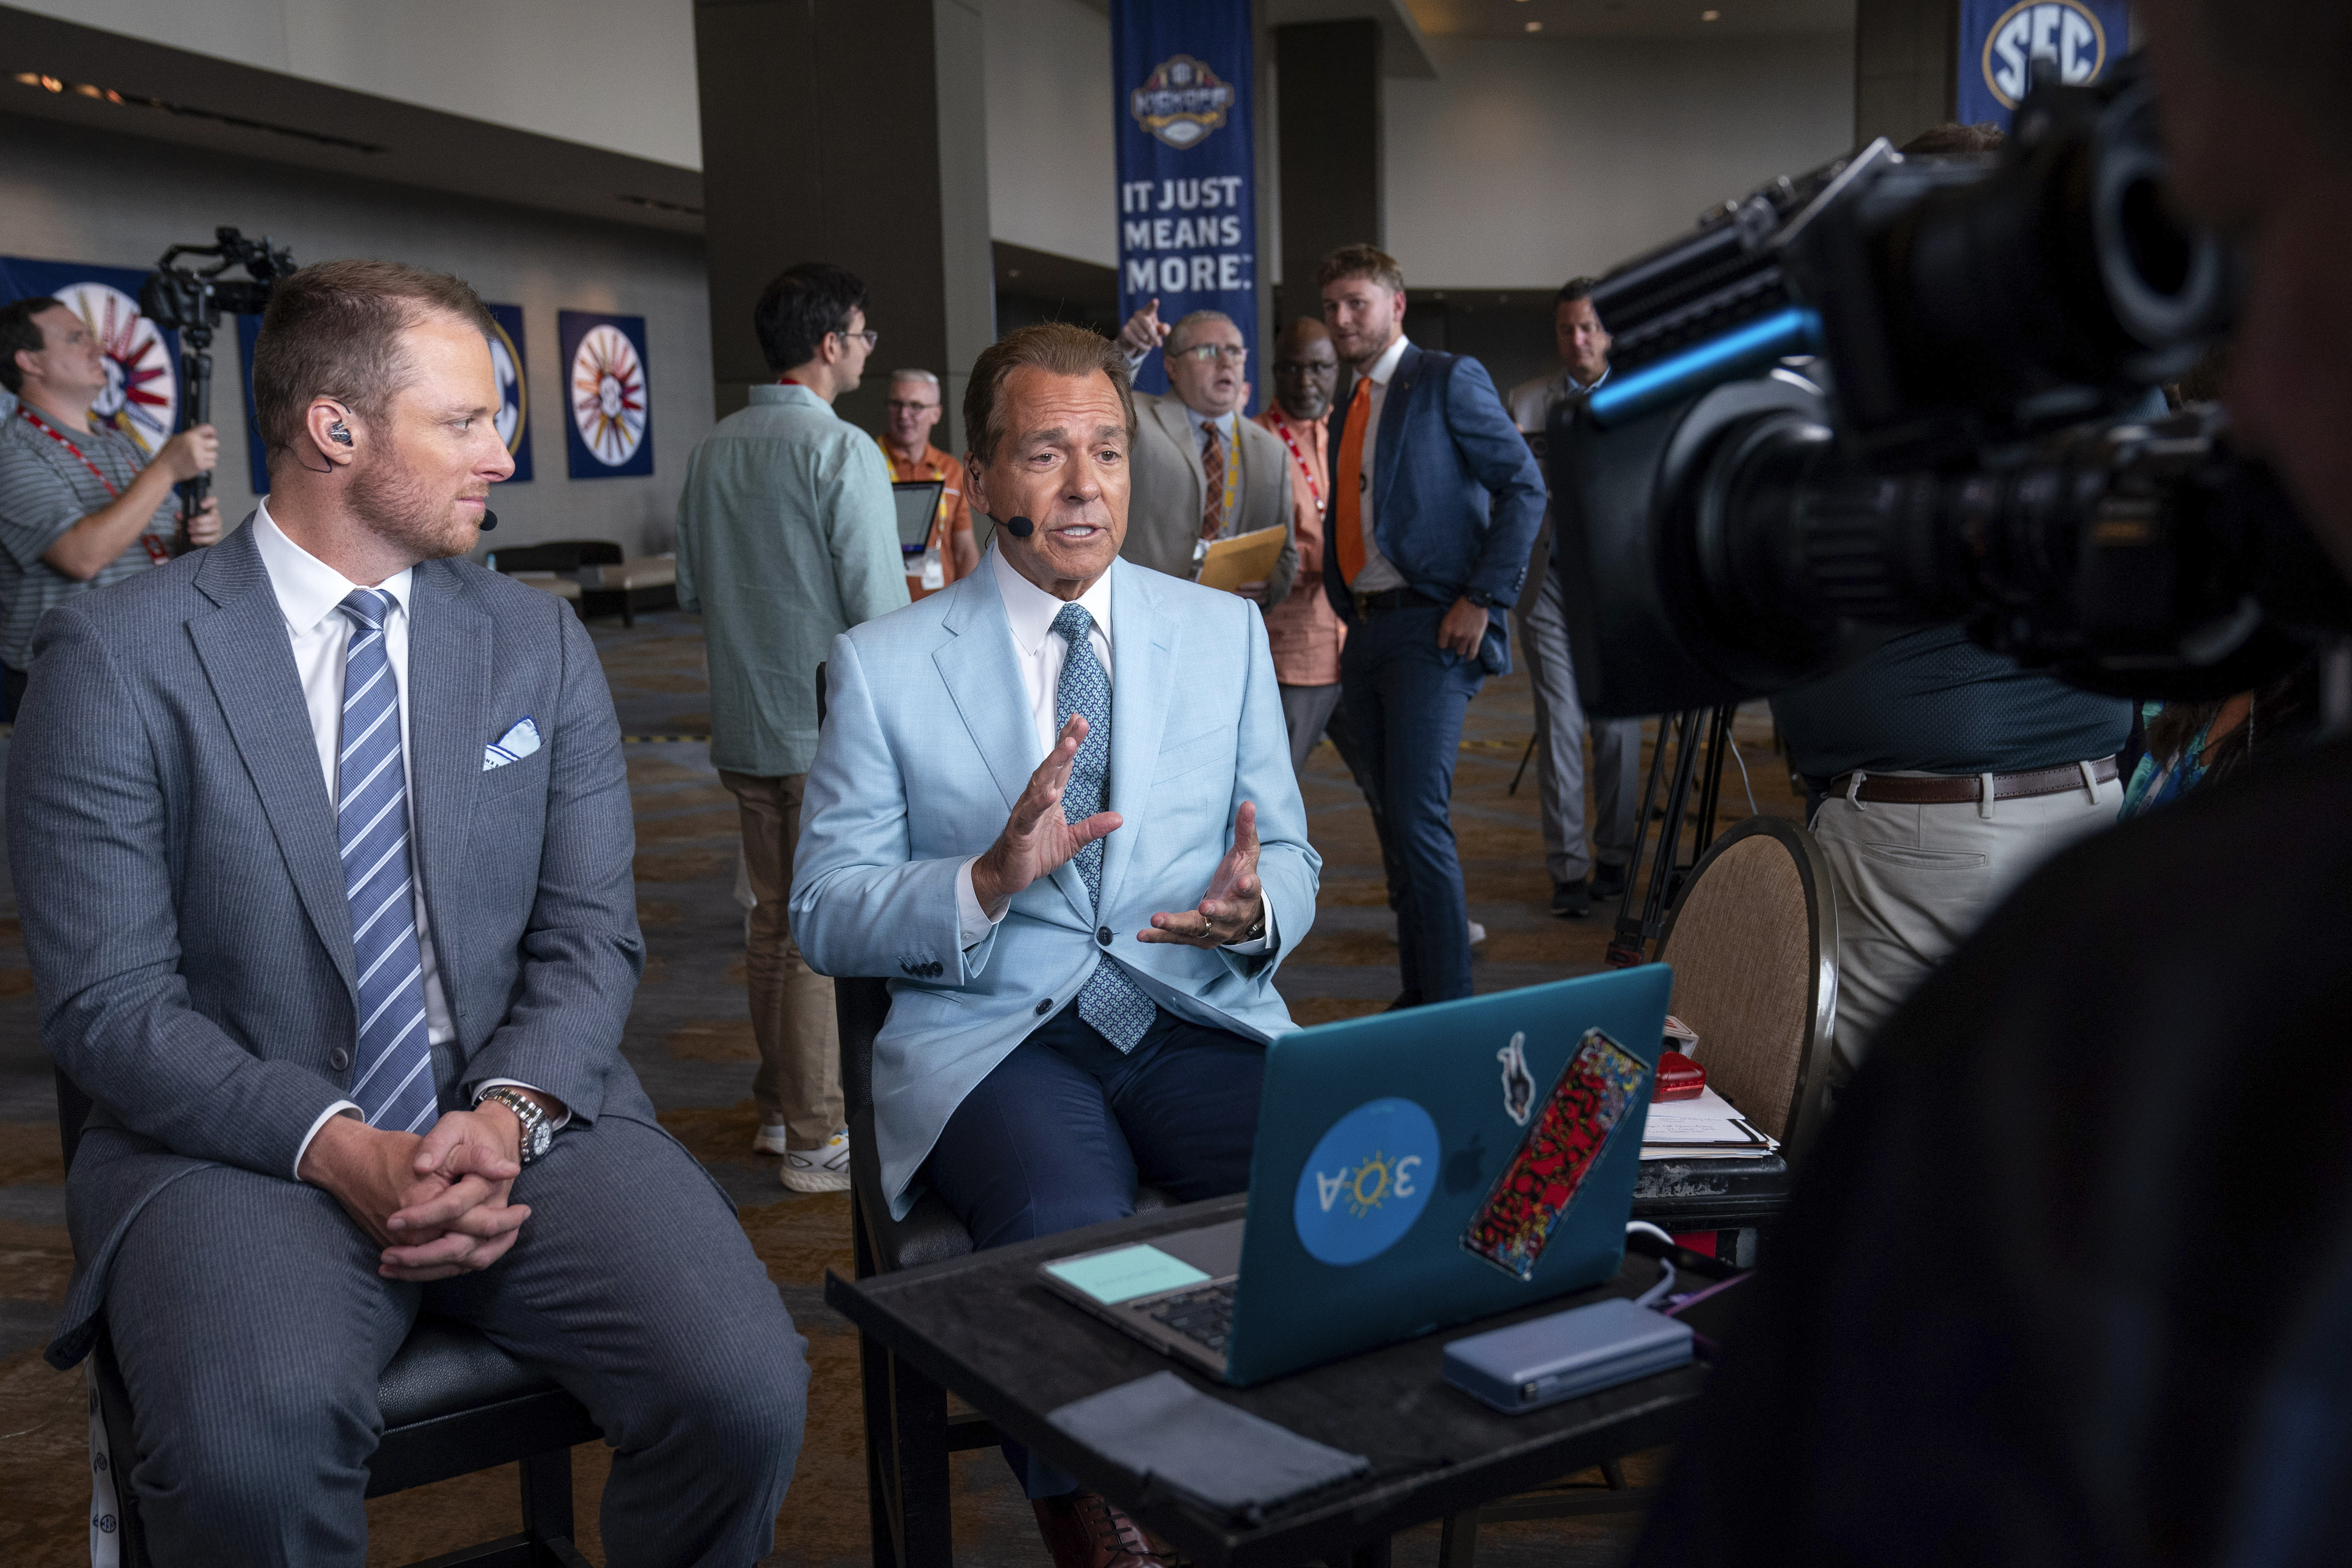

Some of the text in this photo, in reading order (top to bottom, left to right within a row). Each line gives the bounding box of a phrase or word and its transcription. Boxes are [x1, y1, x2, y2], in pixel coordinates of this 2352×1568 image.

[1123, 176, 1243, 213] IT JUST
[1124, 215, 1242, 250] MEANS
